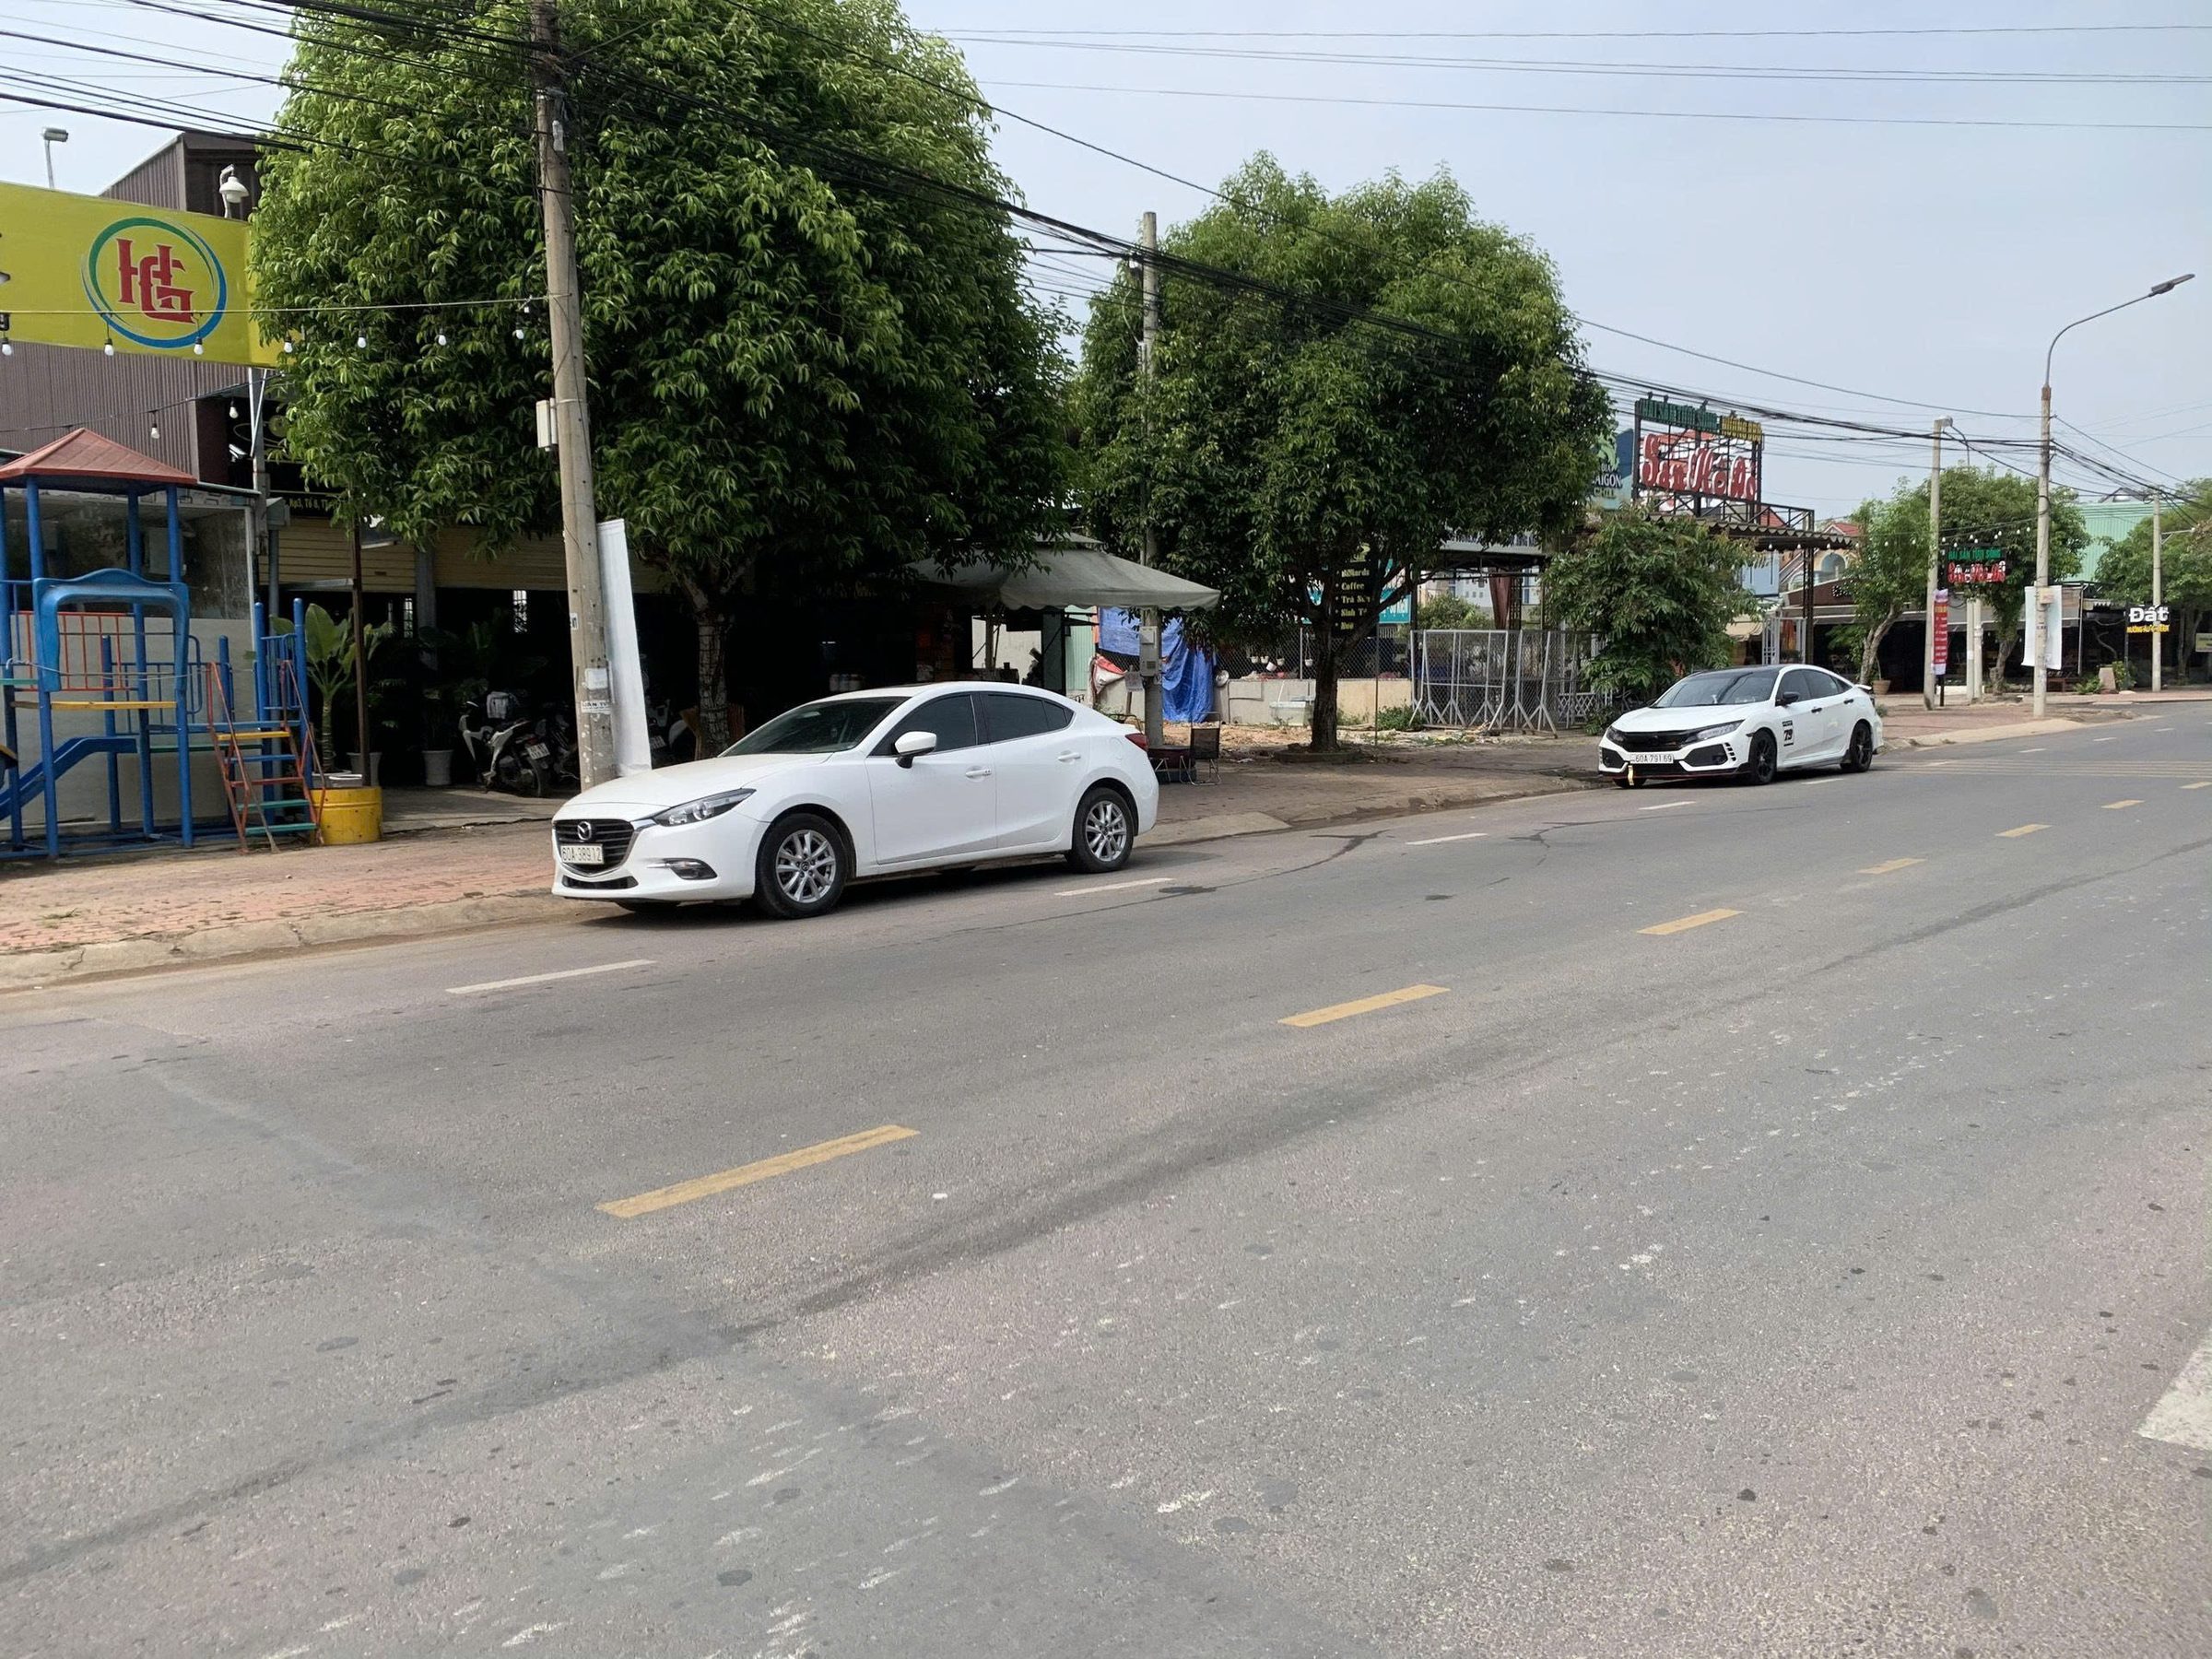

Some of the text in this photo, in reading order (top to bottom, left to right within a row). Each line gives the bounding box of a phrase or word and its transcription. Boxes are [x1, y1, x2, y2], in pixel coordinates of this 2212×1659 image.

[1341, 582, 1364, 591] Coffee
[2128, 605, 2170, 623] Đất
[1783, 729, 1794, 741] 79
